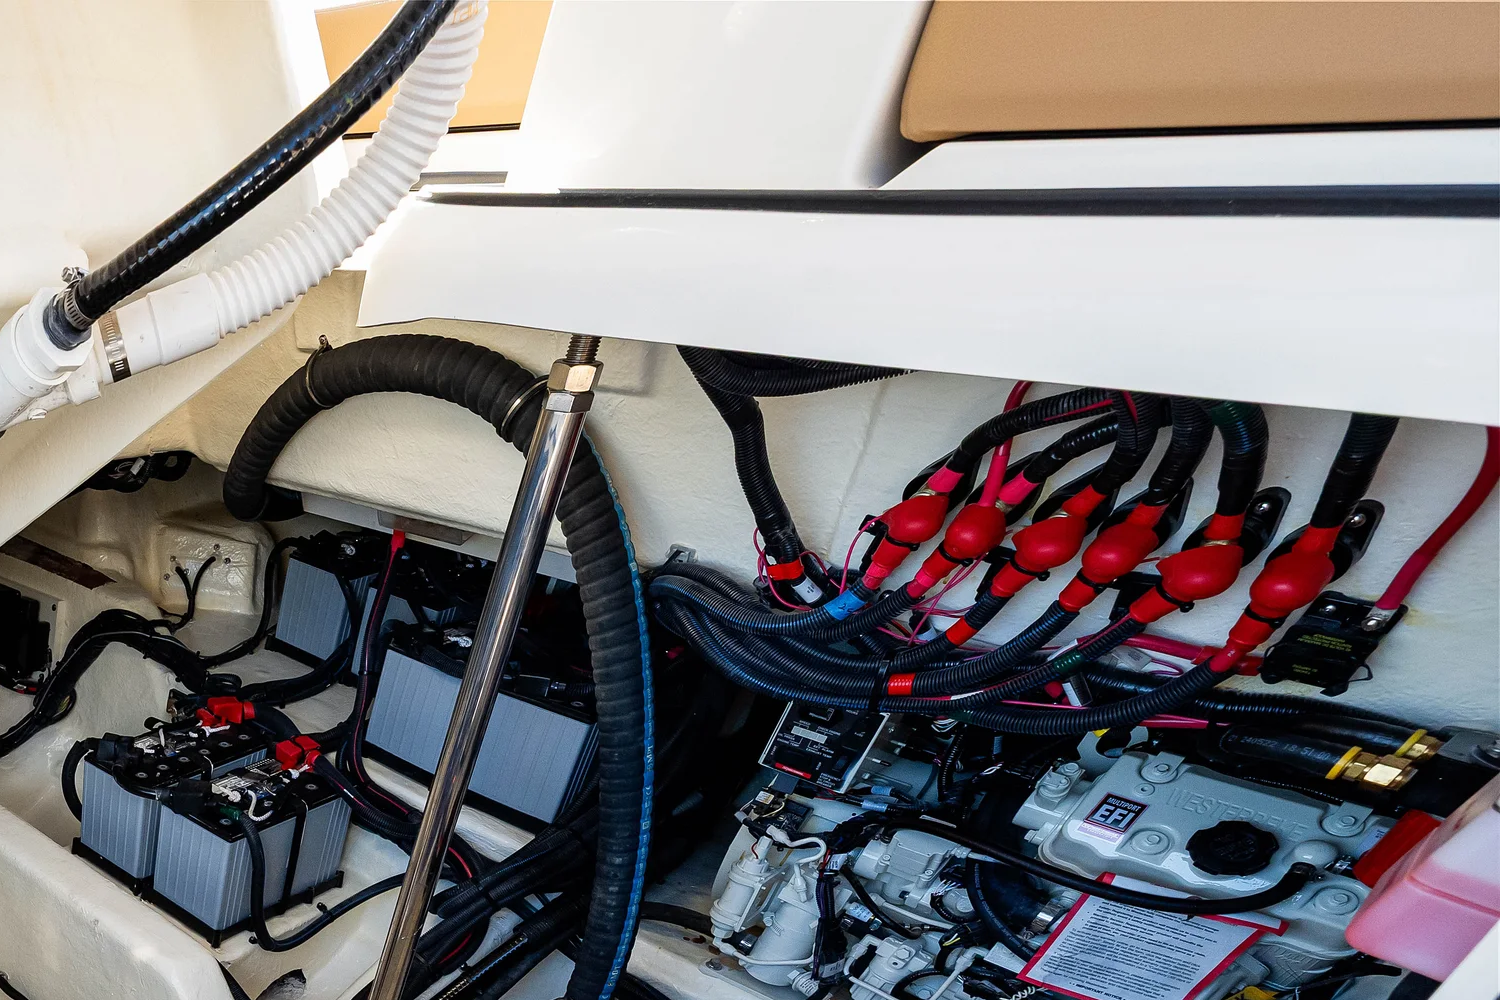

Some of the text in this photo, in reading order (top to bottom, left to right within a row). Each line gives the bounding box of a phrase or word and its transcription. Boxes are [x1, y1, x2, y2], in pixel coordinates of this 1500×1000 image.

[1106, 796, 1141, 812] MULTIPORT
[1092, 802, 1135, 829] EFI
[1075, 983, 1122, 1000] IMPORTANT NOTICE
